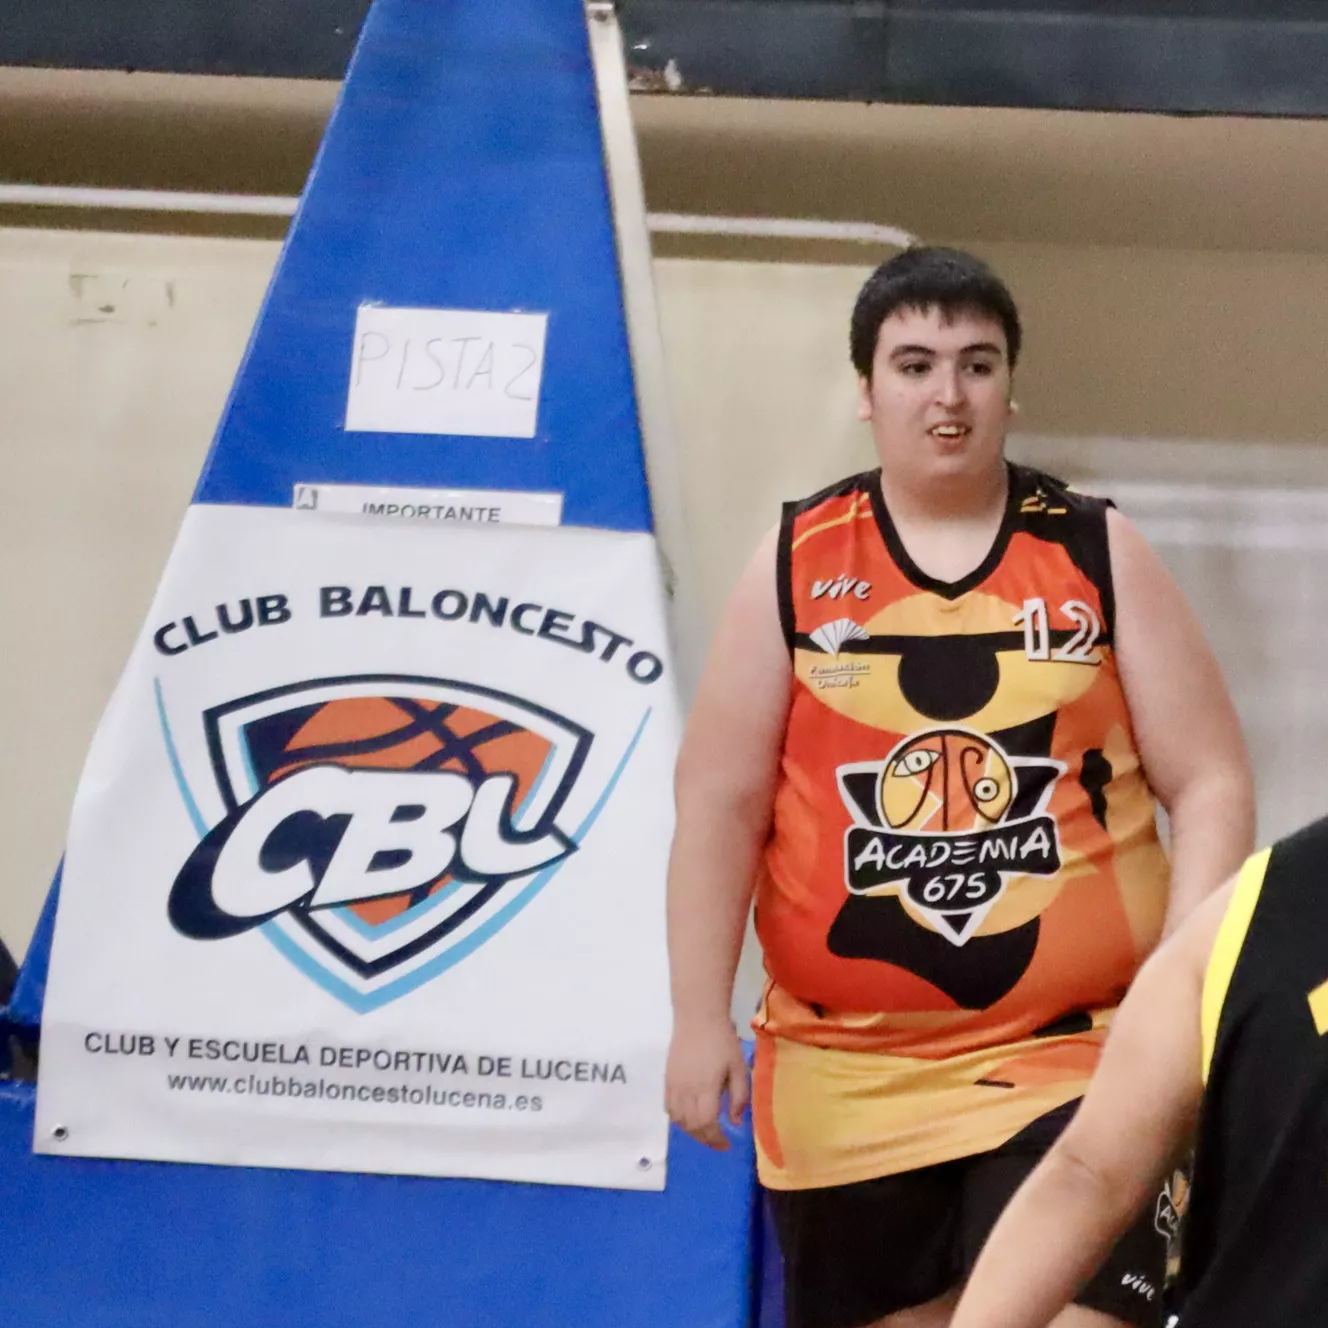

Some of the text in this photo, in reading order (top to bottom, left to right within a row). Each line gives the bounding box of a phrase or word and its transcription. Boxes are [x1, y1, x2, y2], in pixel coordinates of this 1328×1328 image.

[362, 502, 502, 523] IMPORTANTE
[153, 585, 664, 685] CLUB BALONCESTO
[1012, 598, 1101, 664] 12
[854, 826, 1050, 872] ACADEMIA
[923, 872, 987, 902] 675
[84, 1032, 627, 1084] CLUB Y ESCUELA DEPORTIVA DE LUCENA
[167, 1073, 544, 1112] www.clubbaloncestolucena.es
